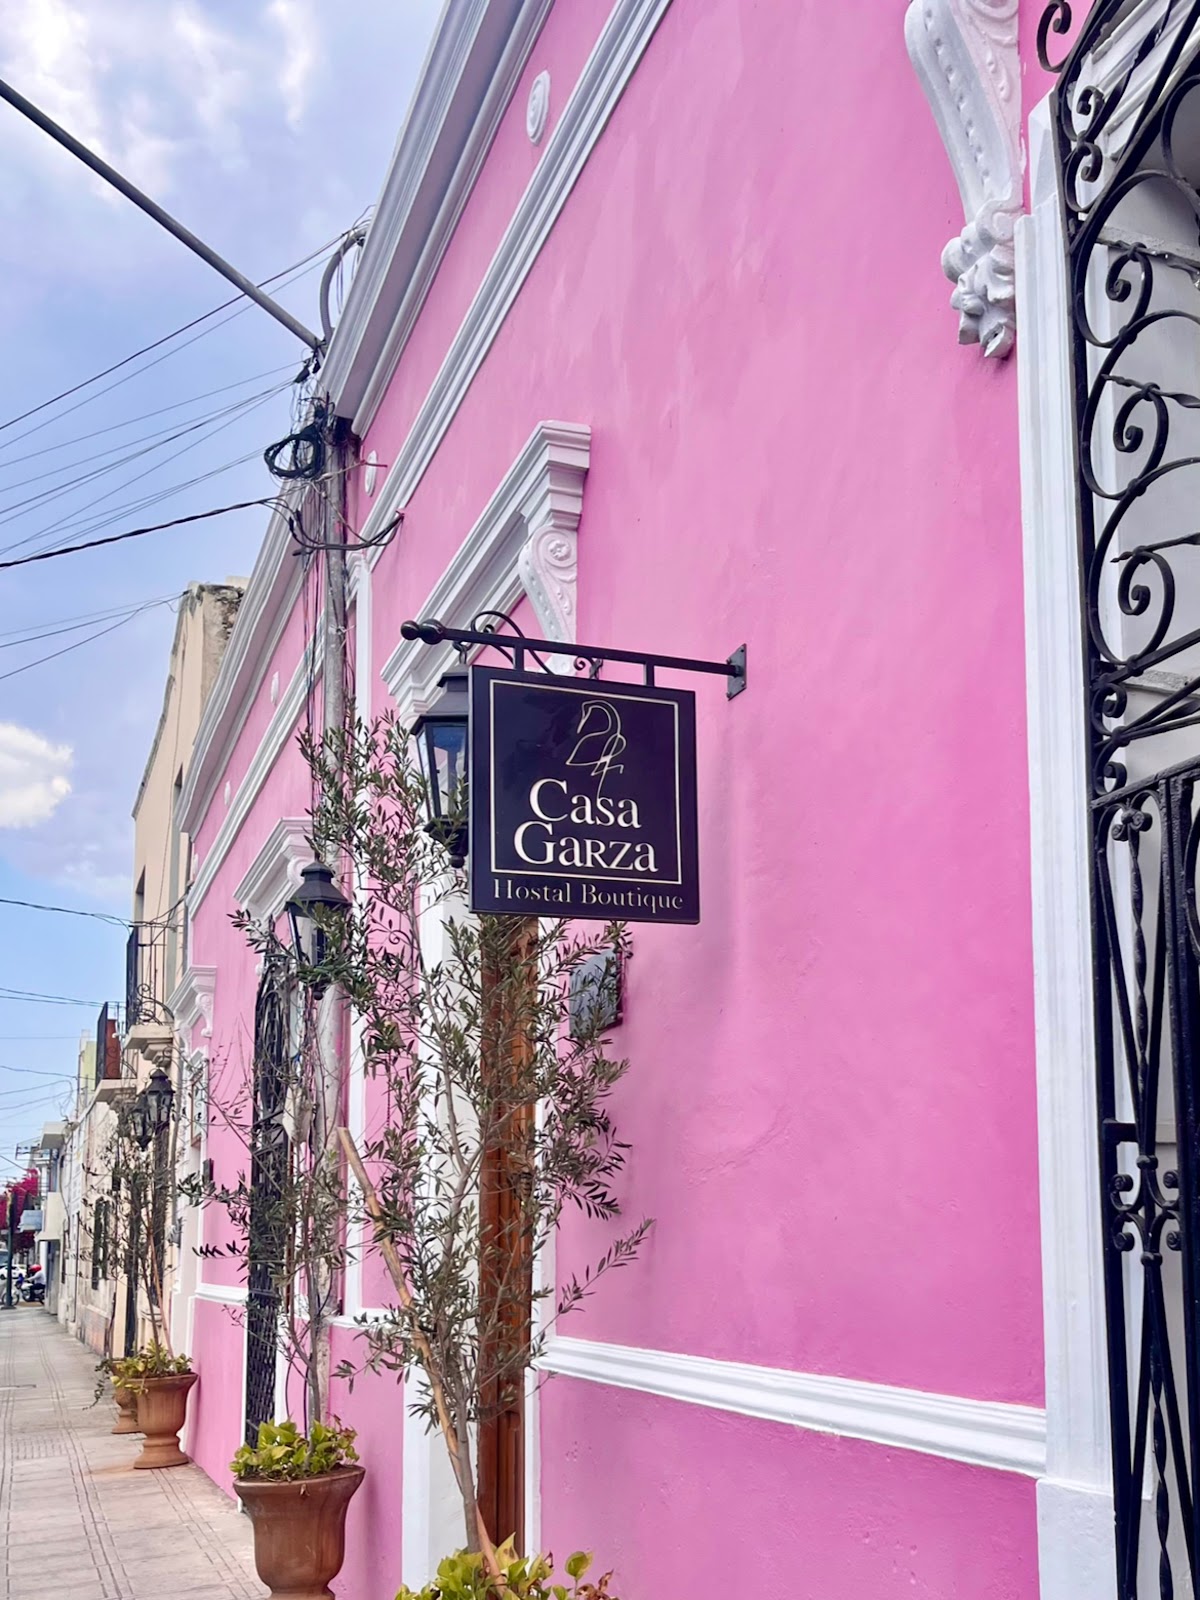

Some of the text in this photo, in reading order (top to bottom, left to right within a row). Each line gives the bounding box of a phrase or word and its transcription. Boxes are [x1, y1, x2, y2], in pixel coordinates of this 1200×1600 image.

[529, 778, 641, 828] Casa
[493, 878, 683, 914] Hostal Boutique
